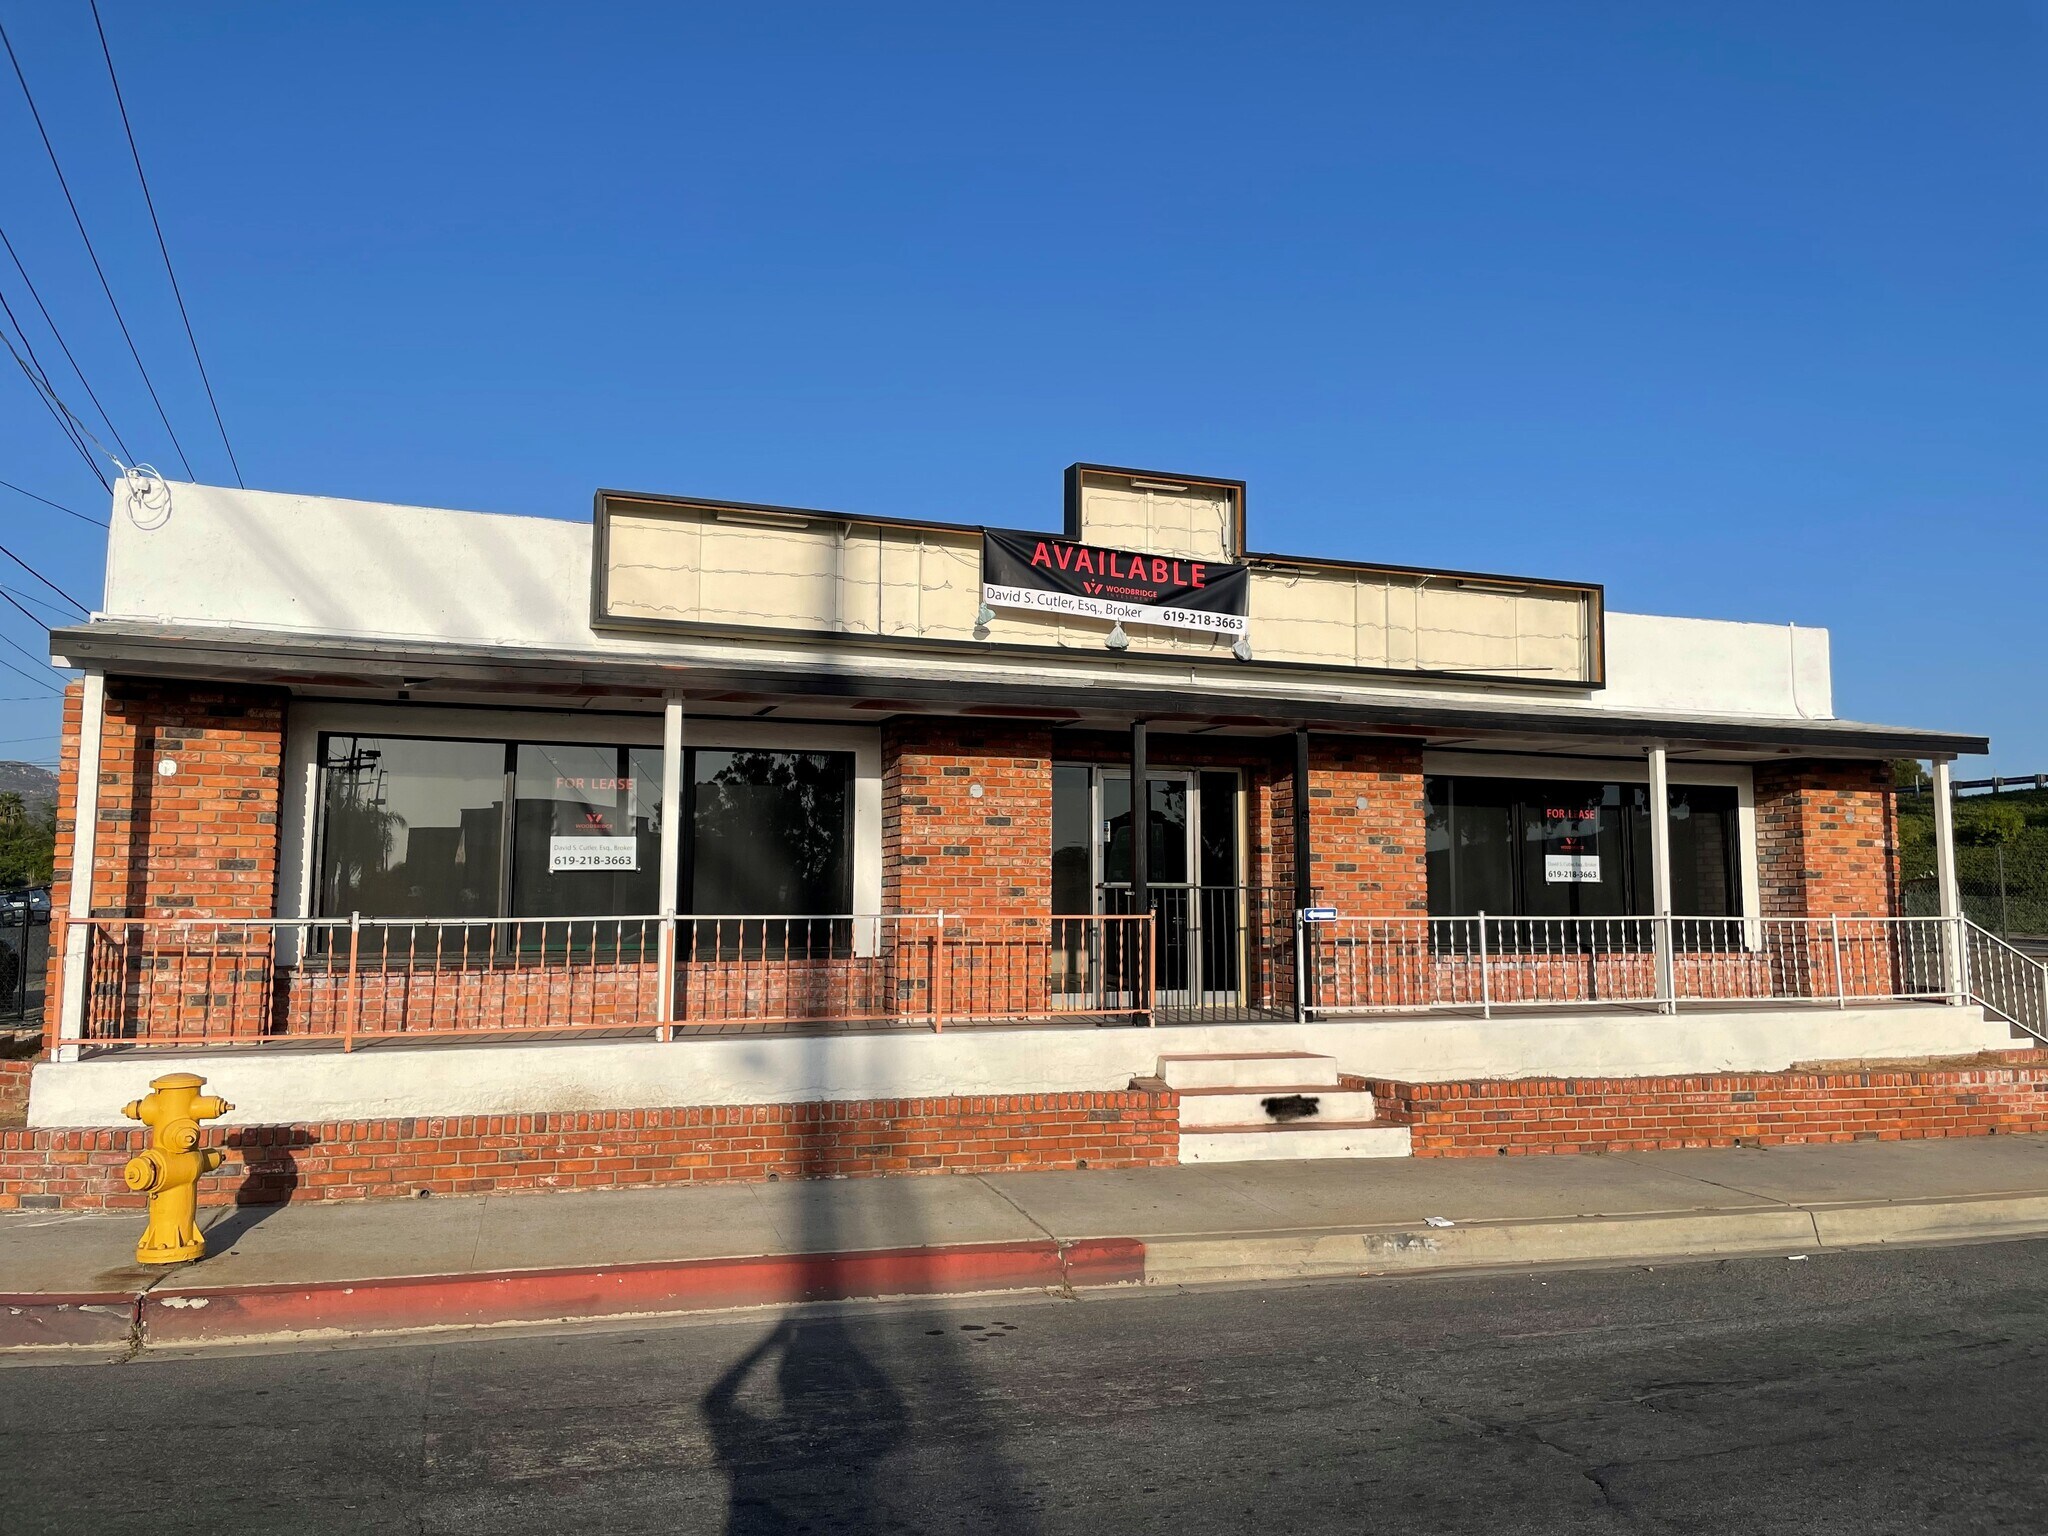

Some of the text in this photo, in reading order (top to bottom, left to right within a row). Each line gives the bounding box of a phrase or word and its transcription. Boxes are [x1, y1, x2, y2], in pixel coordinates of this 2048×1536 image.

[1031, 542, 1206, 588] AVAILABLE
[1106, 585, 1158, 598] WOODBRIDGE
[986, 587, 1142, 618] David S. Cutler, Esq., Broker
[1163, 610, 1243, 629] 619-218-3663
[556, 777, 634, 790] FOR LEASE
[1547, 809, 1564, 819] FOR
[554, 856, 632, 865] 619-218-3663
[1548, 870, 1597, 878] 619-218-3663
